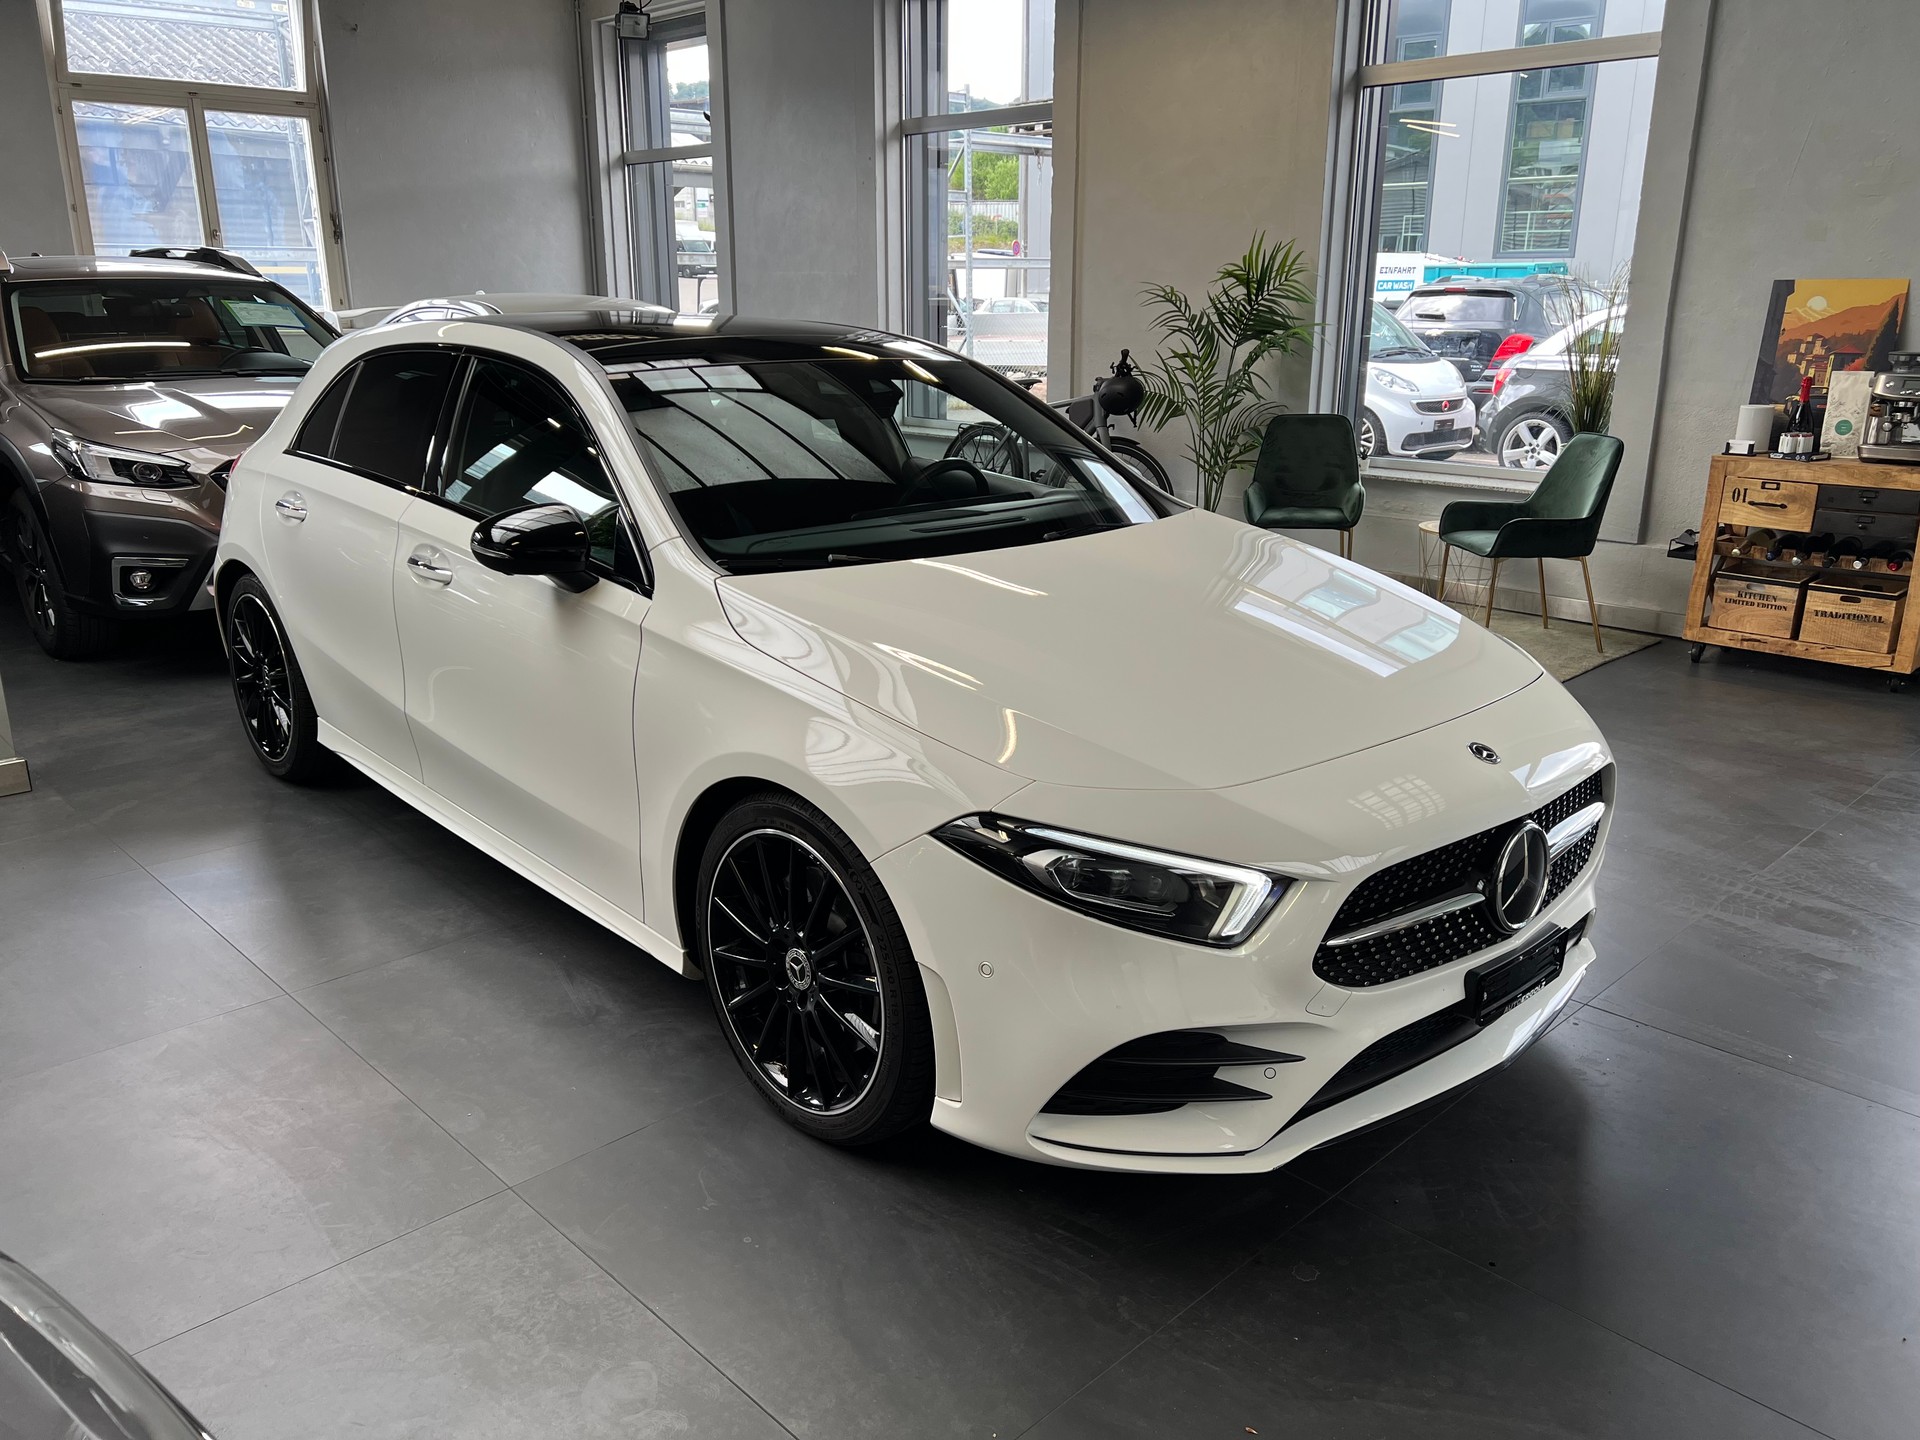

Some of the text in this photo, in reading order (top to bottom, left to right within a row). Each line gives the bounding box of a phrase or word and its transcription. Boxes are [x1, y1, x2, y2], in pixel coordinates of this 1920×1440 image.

[1380, 266, 1416, 274] EINFAHRT
[1378, 281, 1413, 290] CAR WASH
[1732, 487, 1748, 503] 01
[1737, 590, 1777, 602] KITCHEN
[1724, 597, 1787, 611] LIMITED EDITION
[1813, 609, 1885, 624] TRADITIONAL
